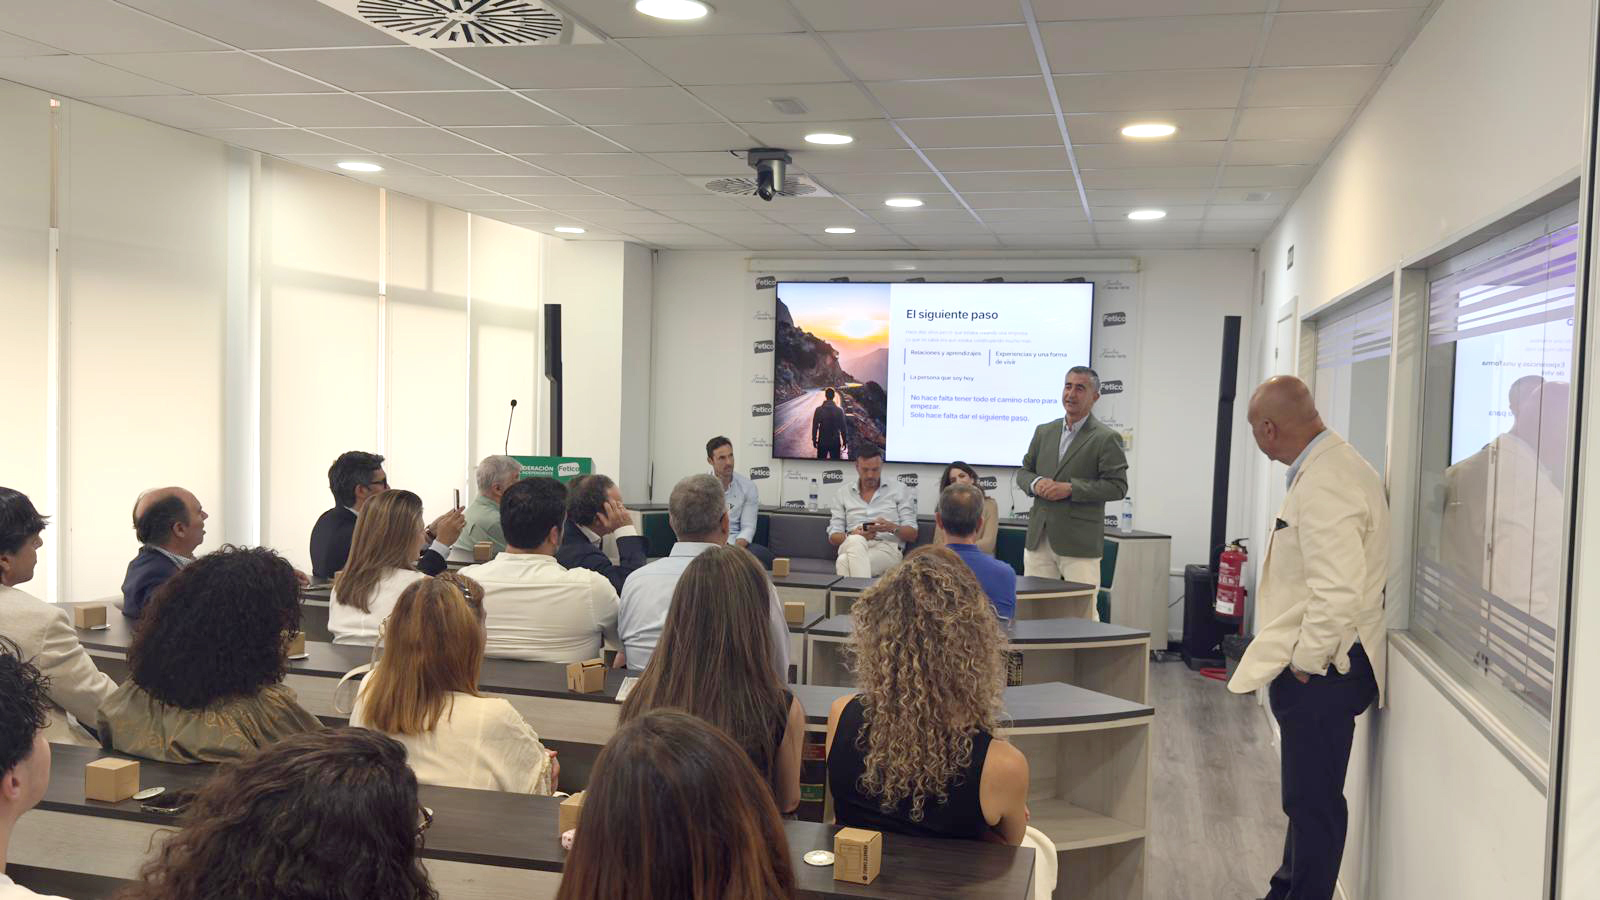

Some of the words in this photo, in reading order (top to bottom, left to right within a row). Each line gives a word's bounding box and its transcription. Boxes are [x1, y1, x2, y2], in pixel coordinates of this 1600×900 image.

[906, 309, 916, 319] El
[918, 309, 969, 321] siguiente
[971, 311, 999, 321] paso
[1103, 314, 1126, 322] Fetico
[754, 342, 775, 350] Fetico
[1100, 383, 1123, 391] Fetico
[938, 394, 954, 402] falta
[997, 396, 1023, 404] camino
[1023, 396, 1041, 404] claro
[910, 403, 941, 411] empezar.
[910, 411, 925, 419] Solo
[959, 412, 970, 420] dar
[978, 413, 1010, 422] siguiente
[1010, 415, 1030, 423] paso.
[750, 469, 770, 477] Fetico
[822, 472, 843, 480] Fetico
